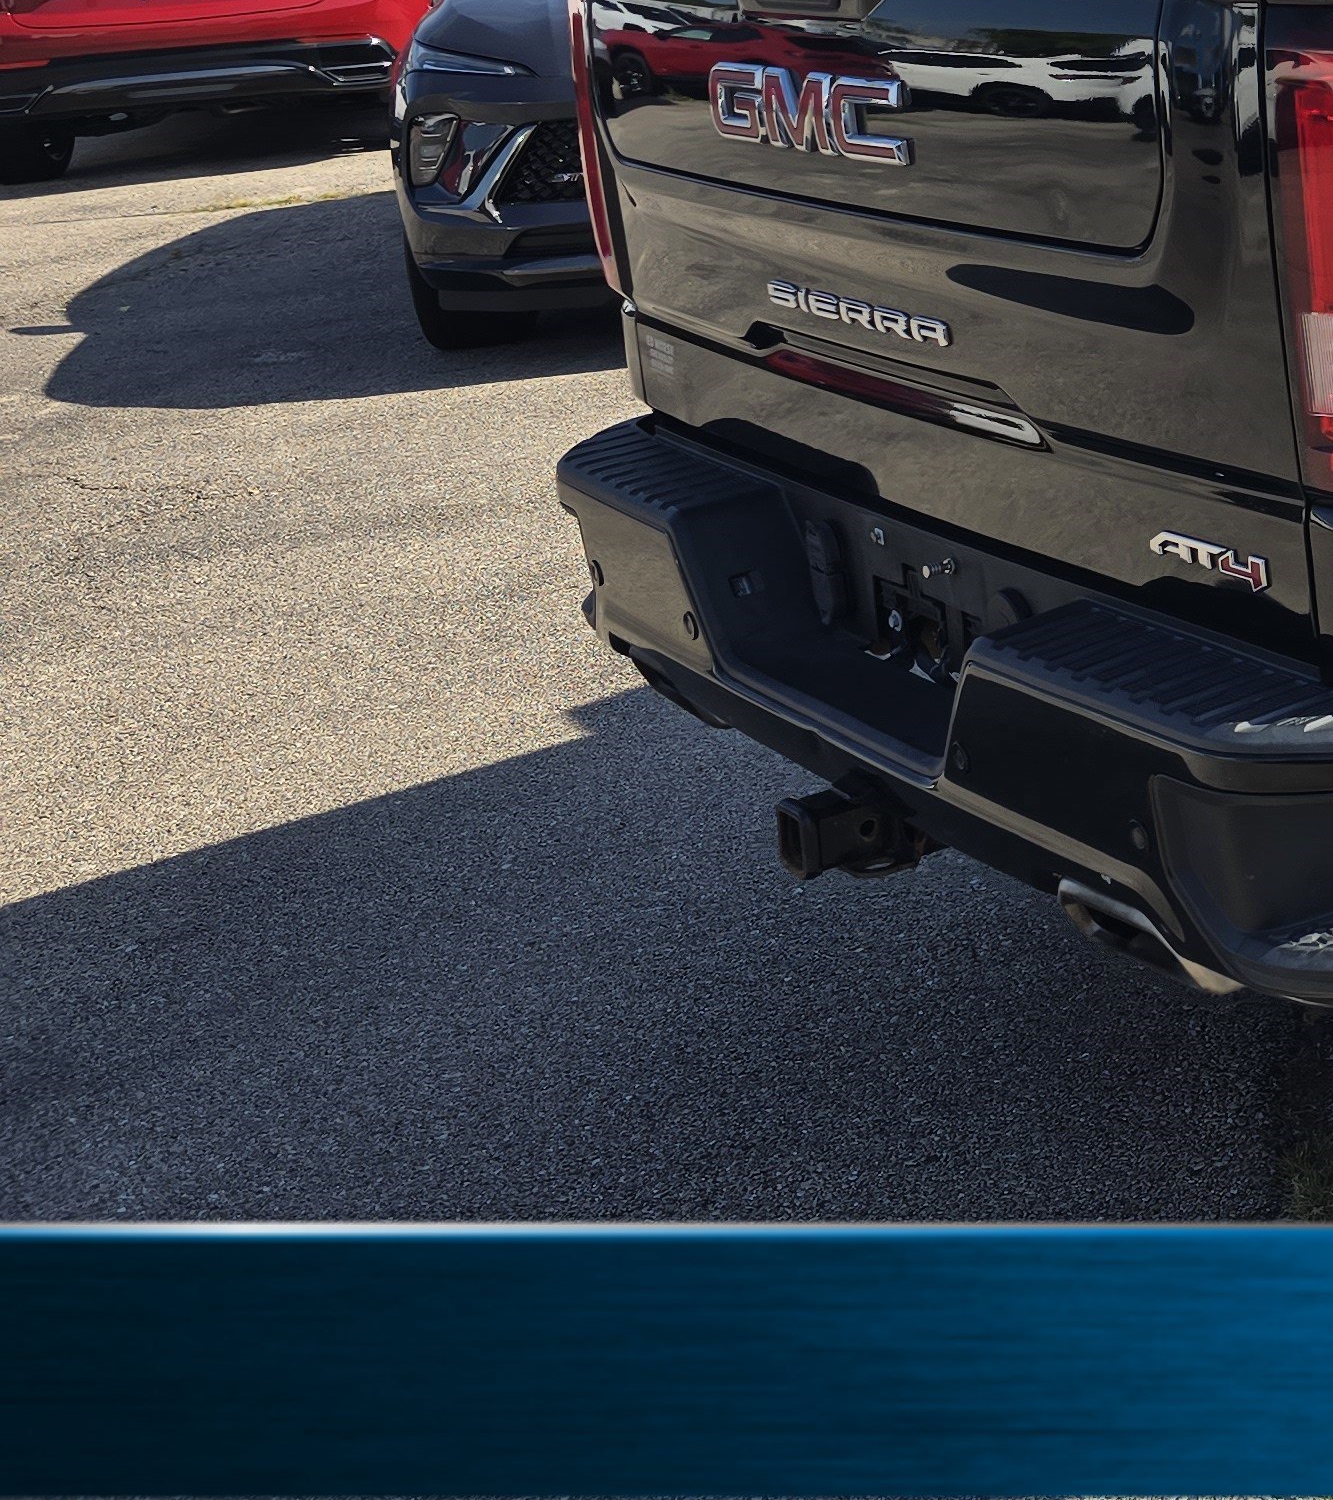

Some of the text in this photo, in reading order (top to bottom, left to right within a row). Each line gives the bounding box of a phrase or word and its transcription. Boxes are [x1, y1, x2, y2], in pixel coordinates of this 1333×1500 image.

[708, 61, 914, 166] GMC
[766, 279, 952, 347] SIERRA
[1149, 530, 1271, 593] AT4
